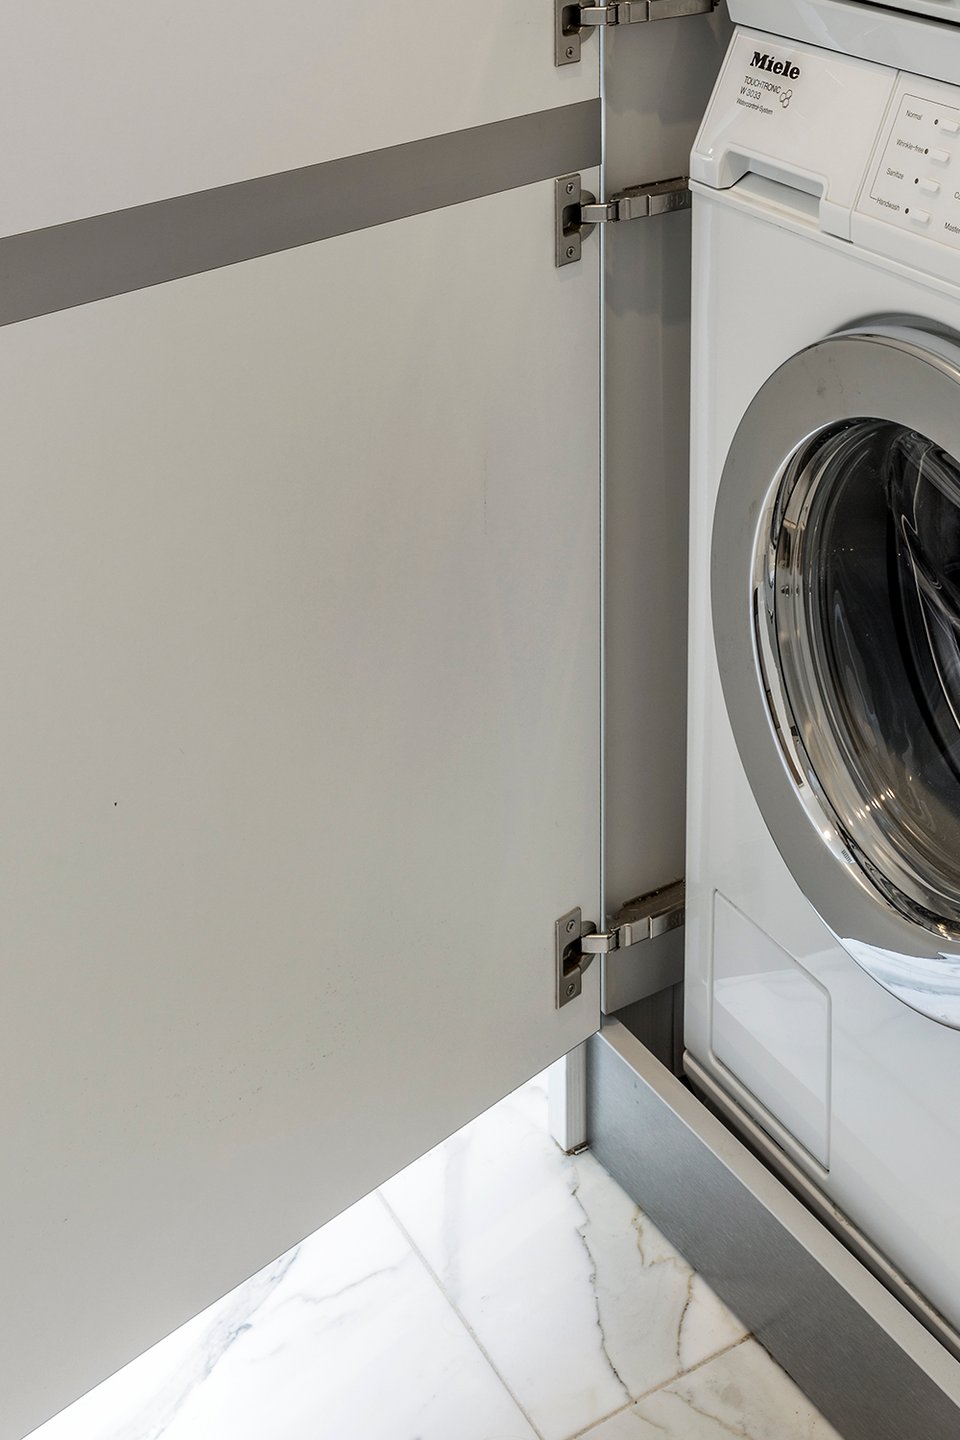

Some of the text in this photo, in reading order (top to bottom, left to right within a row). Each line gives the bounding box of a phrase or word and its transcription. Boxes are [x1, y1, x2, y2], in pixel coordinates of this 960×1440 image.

[750, 51, 801, 80] Miele
[740, 86, 747, 95] W
[744, 75, 781, 94] TOUCHTRONIC
[905, 110, 923, 121] Normal
[944, 222, 960, 234] Master
